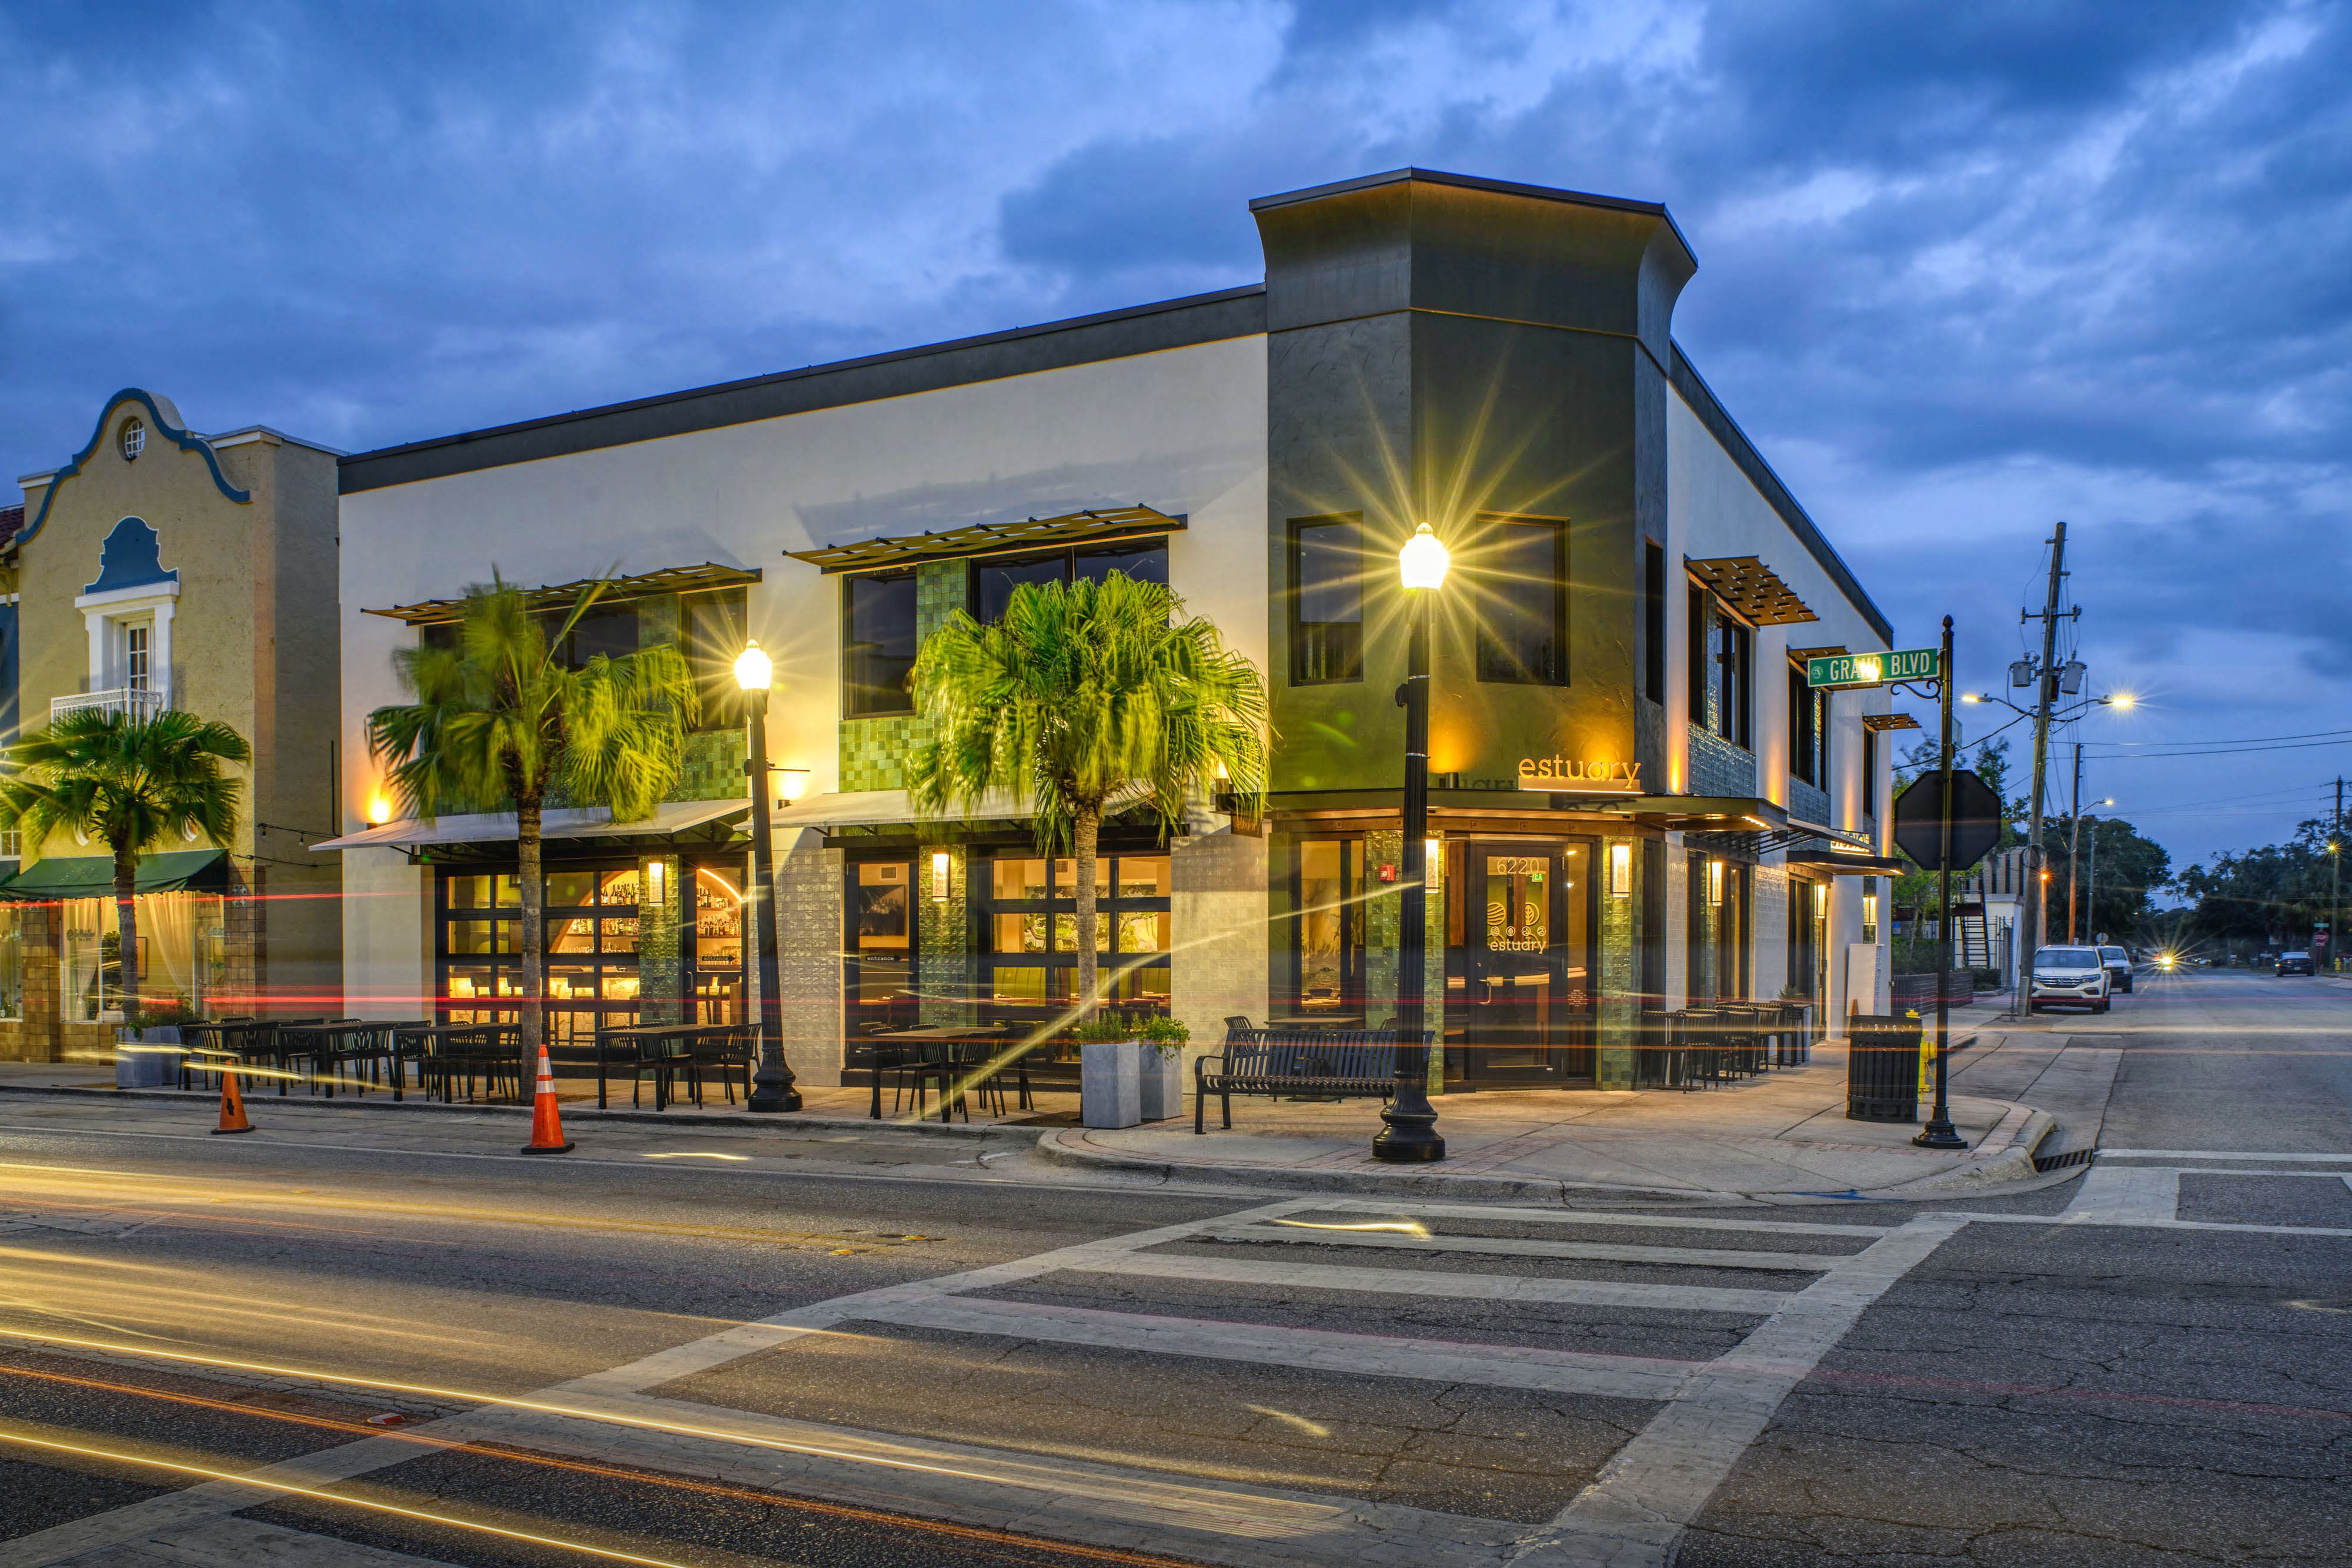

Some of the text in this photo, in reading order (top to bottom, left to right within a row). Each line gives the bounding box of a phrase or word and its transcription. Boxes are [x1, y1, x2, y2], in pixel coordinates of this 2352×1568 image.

[1892, 652, 1930, 676] BLVD
[1518, 754, 1641, 789] estuary
[1497, 858, 1539, 875] 6220
[1489, 938, 1547, 954] estuary
